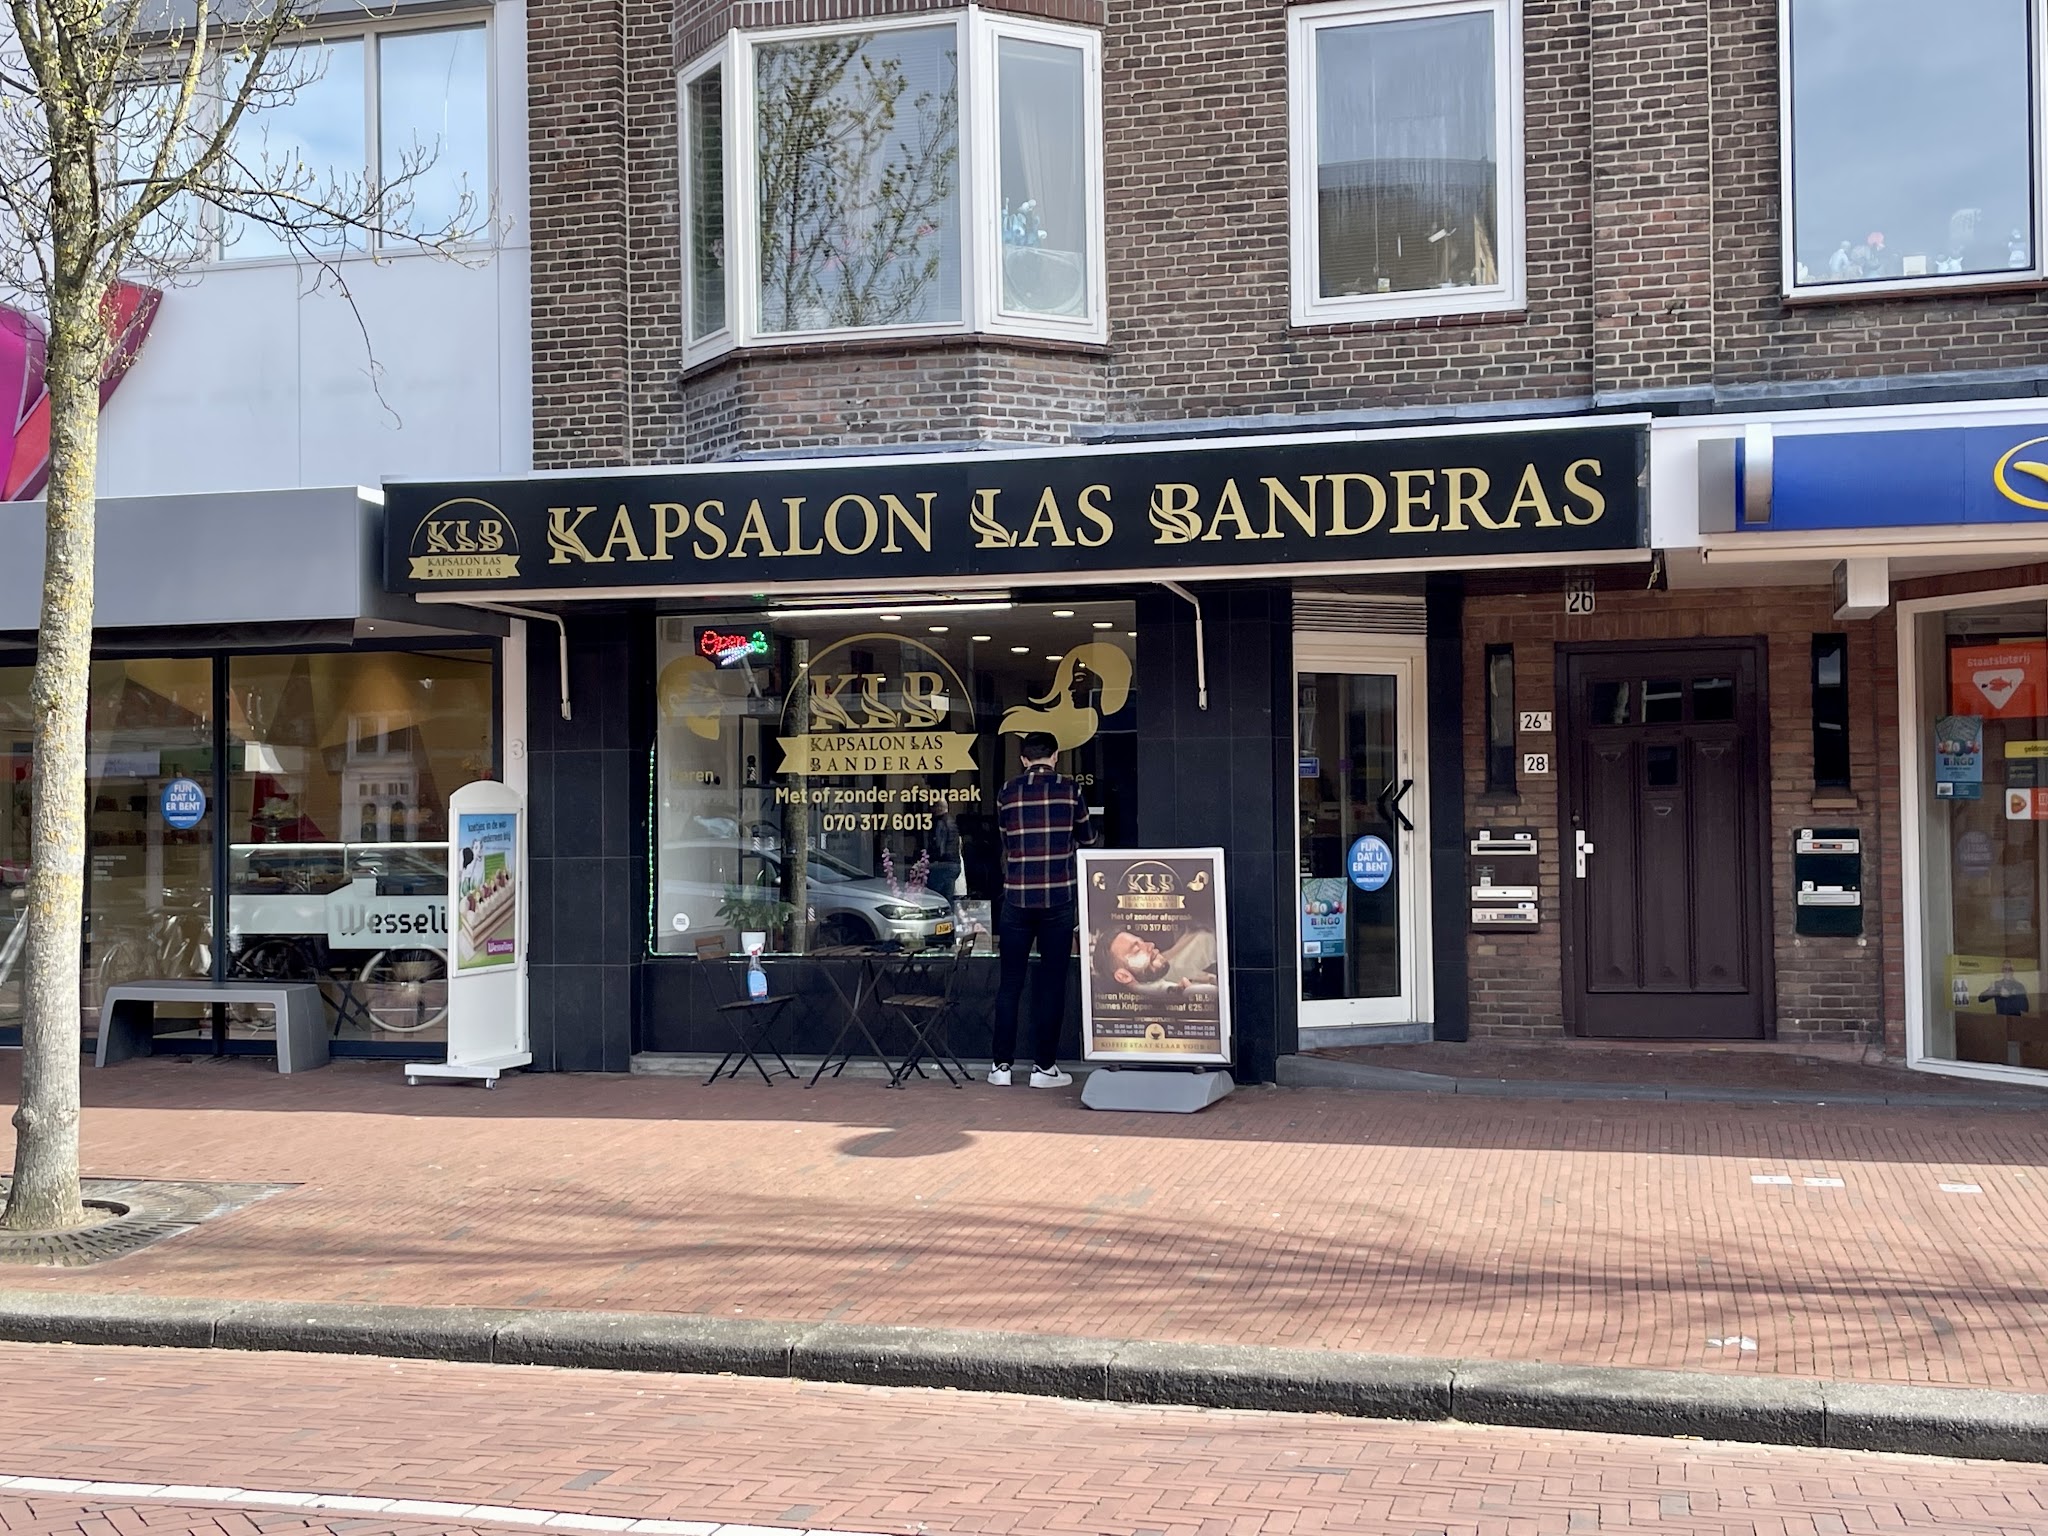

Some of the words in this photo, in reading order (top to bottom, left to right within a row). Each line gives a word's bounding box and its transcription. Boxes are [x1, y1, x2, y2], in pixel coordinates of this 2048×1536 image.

[547, 491, 939, 564] KAPSALON
[969, 484, 1114, 549] LAS
[1148, 458, 1607, 546] BANDERAS
[427, 520, 504, 553] KLB
[427, 557, 480, 566] KAPSALON
[483, 556, 501, 565] LAS
[427, 568, 501, 577] BANDERAS
[701, 631, 747, 654] Open
[1967, 653, 2031, 667] Staatsloterij
[810, 671, 947, 730] KLB
[811, 736, 905, 751] KAPSALON
[911, 735, 943, 750] LAS
[811, 755, 943, 772] BANDERAS
[1527, 756, 1546, 772] 28
[174, 784, 192, 793] FIJN
[775, 786, 807, 804] Met
[812, 786, 831, 803] of
[834, 785, 897, 803] zonder
[900, 784, 981, 806] afspraak
[170, 793, 187, 802] DAT
[189, 793, 196, 802] U
[166, 802, 176, 811] ER
[179, 802, 201, 811] BENT
[823, 813, 856, 832] 070
[860, 813, 889, 831] 317
[892, 812, 933, 831] 6013
[1361, 842, 1380, 851] FIJN
[1357, 852, 1373, 861] DAT
[1376, 852, 1383, 860] U
[1352, 862, 1363, 872] ER
[1366, 862, 1388, 872] BENT
[1128, 874, 1175, 893] KLB
[1125, 912, 1133, 920] of
[1134, 912, 1159, 921] zonder
[1150, 923, 1161, 931] 317
